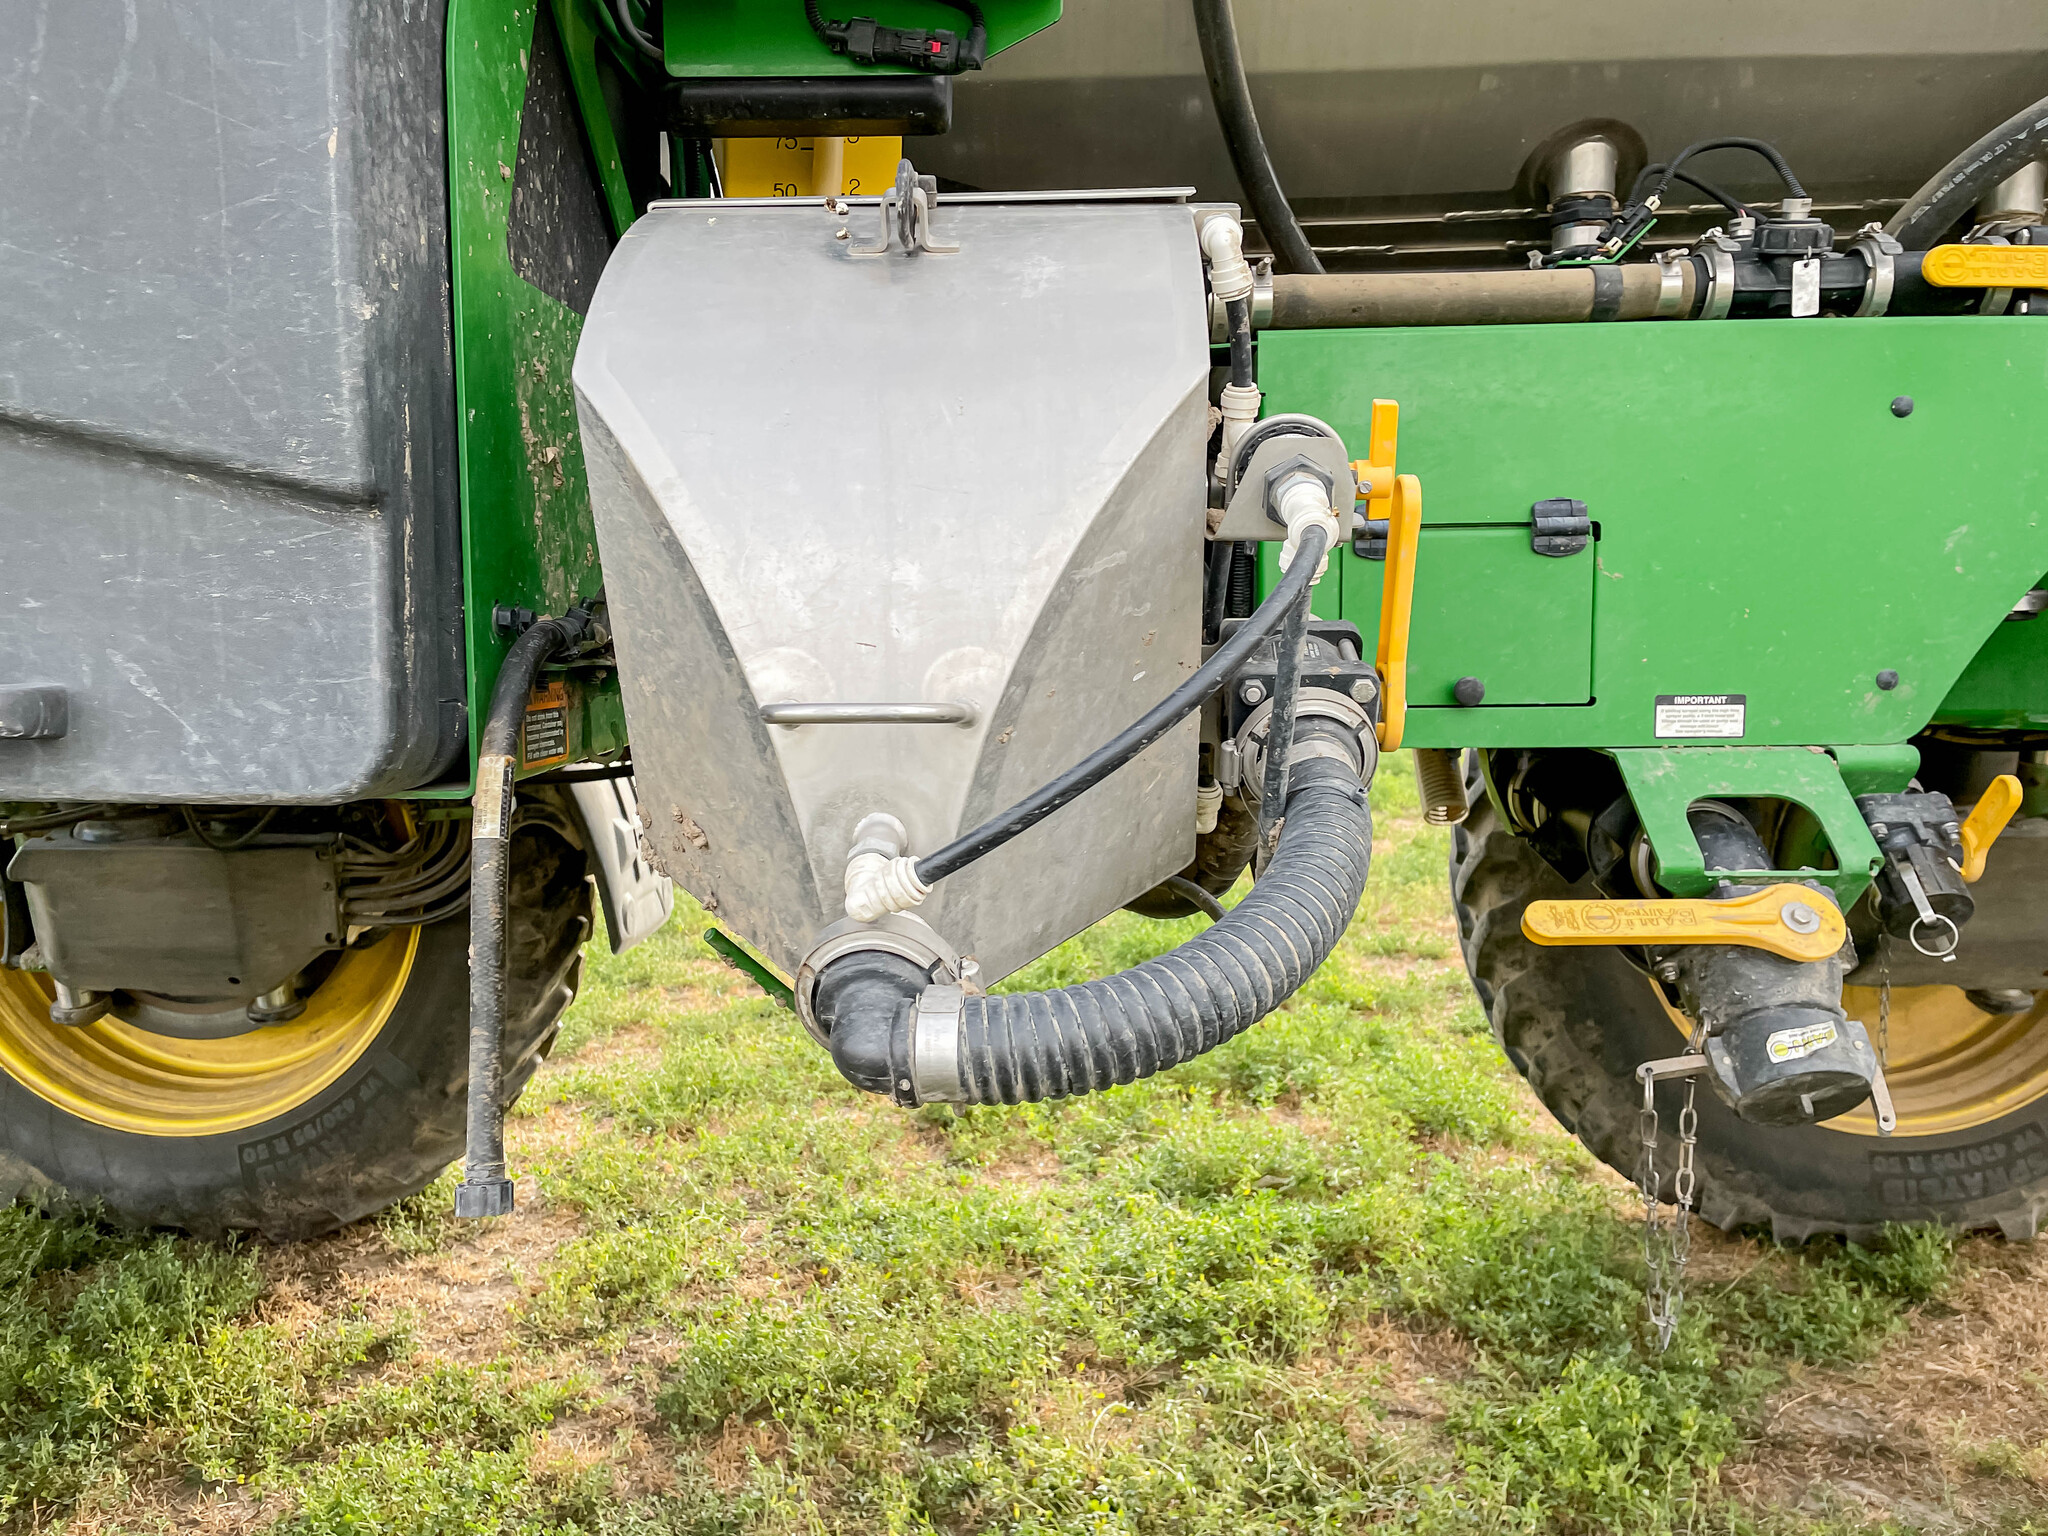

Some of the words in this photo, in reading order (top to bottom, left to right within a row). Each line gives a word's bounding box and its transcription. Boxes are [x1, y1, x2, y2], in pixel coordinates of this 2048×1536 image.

[776, 137, 798, 149] 75
[773, 183, 797, 197] 50
[849, 179, 860, 196] 2
[1674, 696, 1728, 704] IMPORTANT
